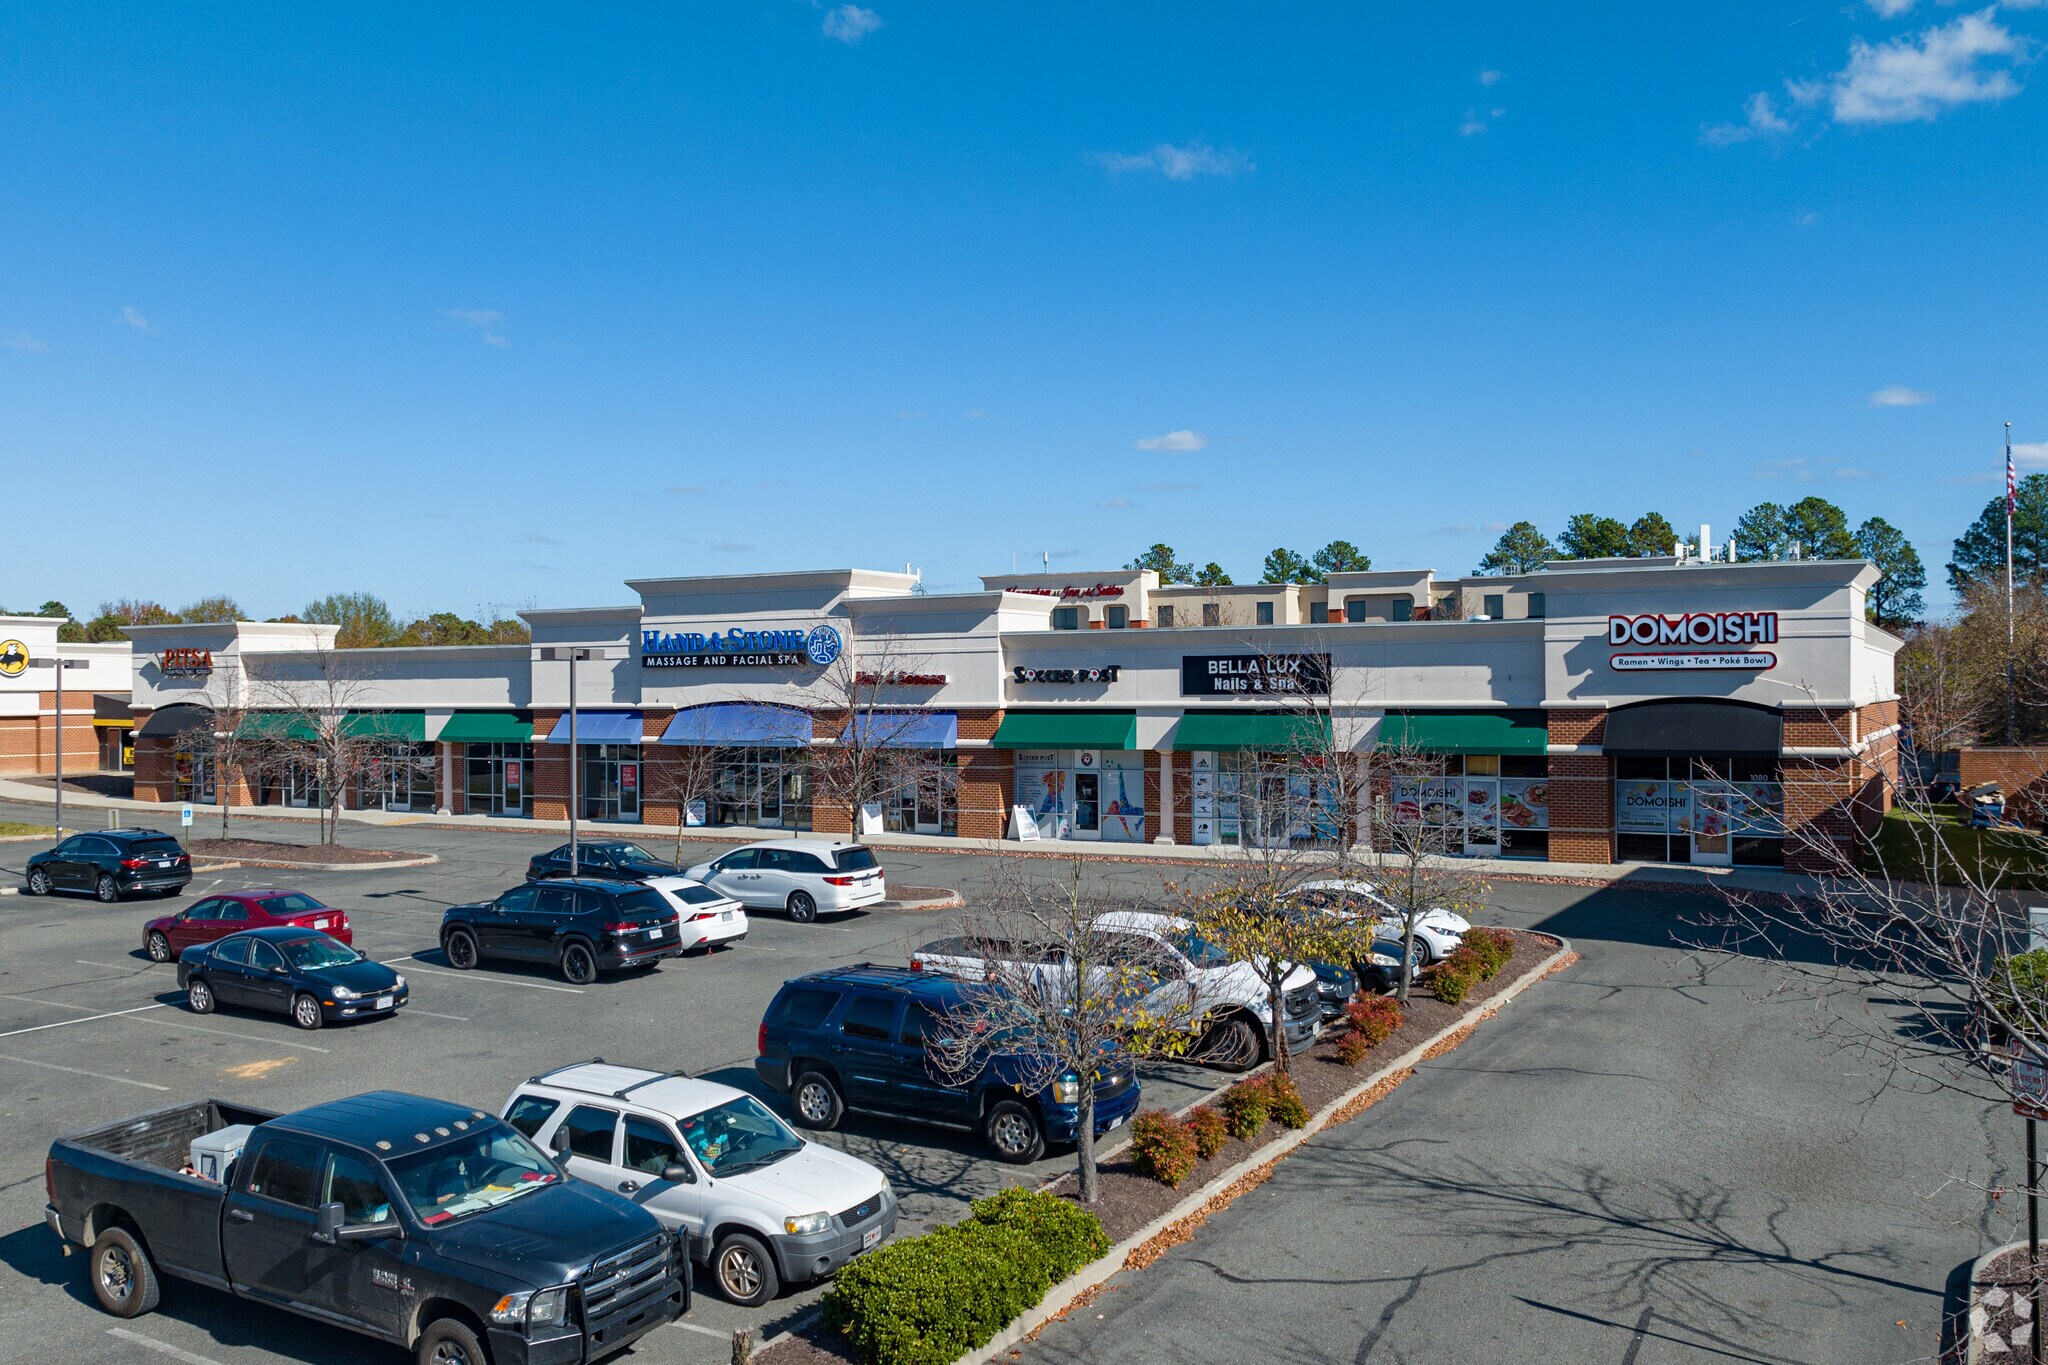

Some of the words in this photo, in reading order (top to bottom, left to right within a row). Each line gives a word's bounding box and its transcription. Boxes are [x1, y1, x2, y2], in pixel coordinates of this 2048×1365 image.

[1061, 586, 1083, 599] Inn
[1093, 583, 1124, 597] Suites
[1609, 613, 1777, 645] DOMOISHI
[641, 630, 707, 652] HAND
[709, 631, 724, 651] &
[727, 627, 805, 651] STONE
[163, 648, 213, 667] PITSA
[646, 656, 698, 666] MASSAGE
[703, 656, 727, 666] AND
[733, 655, 773, 665] FACIAL
[778, 654, 799, 664] SPA
[1618, 658, 1648, 666] Ramen
[1657, 657, 1685, 667] Wings
[1694, 657, 1710, 665] Tea
[1719, 656, 1741, 665] Poké
[1743, 656, 1767, 665] Bowl
[1208, 660, 1260, 674] BELLA
[1266, 659, 1300, 673] LUX
[1013, 666, 1075, 684] SOCCER
[1078, 665, 1121, 683] POST
[1214, 677, 1248, 690] Nails
[1253, 678, 1263, 690] &
[1750, 774, 1769, 782] 1080
[1401, 787, 1456, 798] DOMOISHI
[1626, 796, 1686, 808] DOMOISHI
